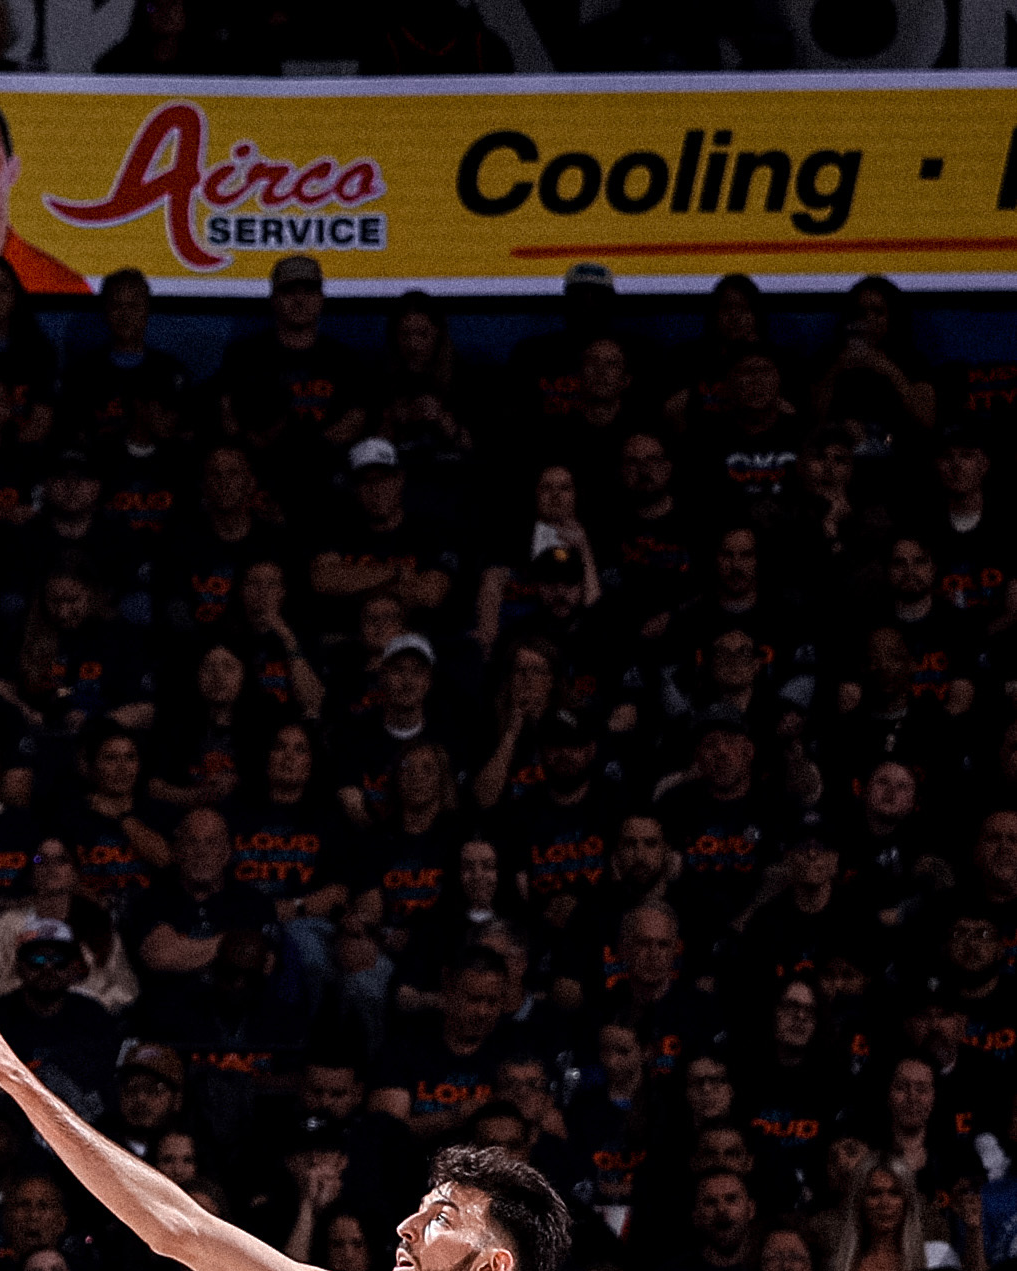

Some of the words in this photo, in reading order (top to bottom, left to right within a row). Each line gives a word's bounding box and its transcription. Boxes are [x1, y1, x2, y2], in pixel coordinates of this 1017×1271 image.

[45, 99, 385, 271] Airco
[457, 130, 862, 234] Cooling
[209, 215, 382, 248] SERVICE
[233, 832, 321, 854] LOUD
[233, 859, 316, 885] CITY
